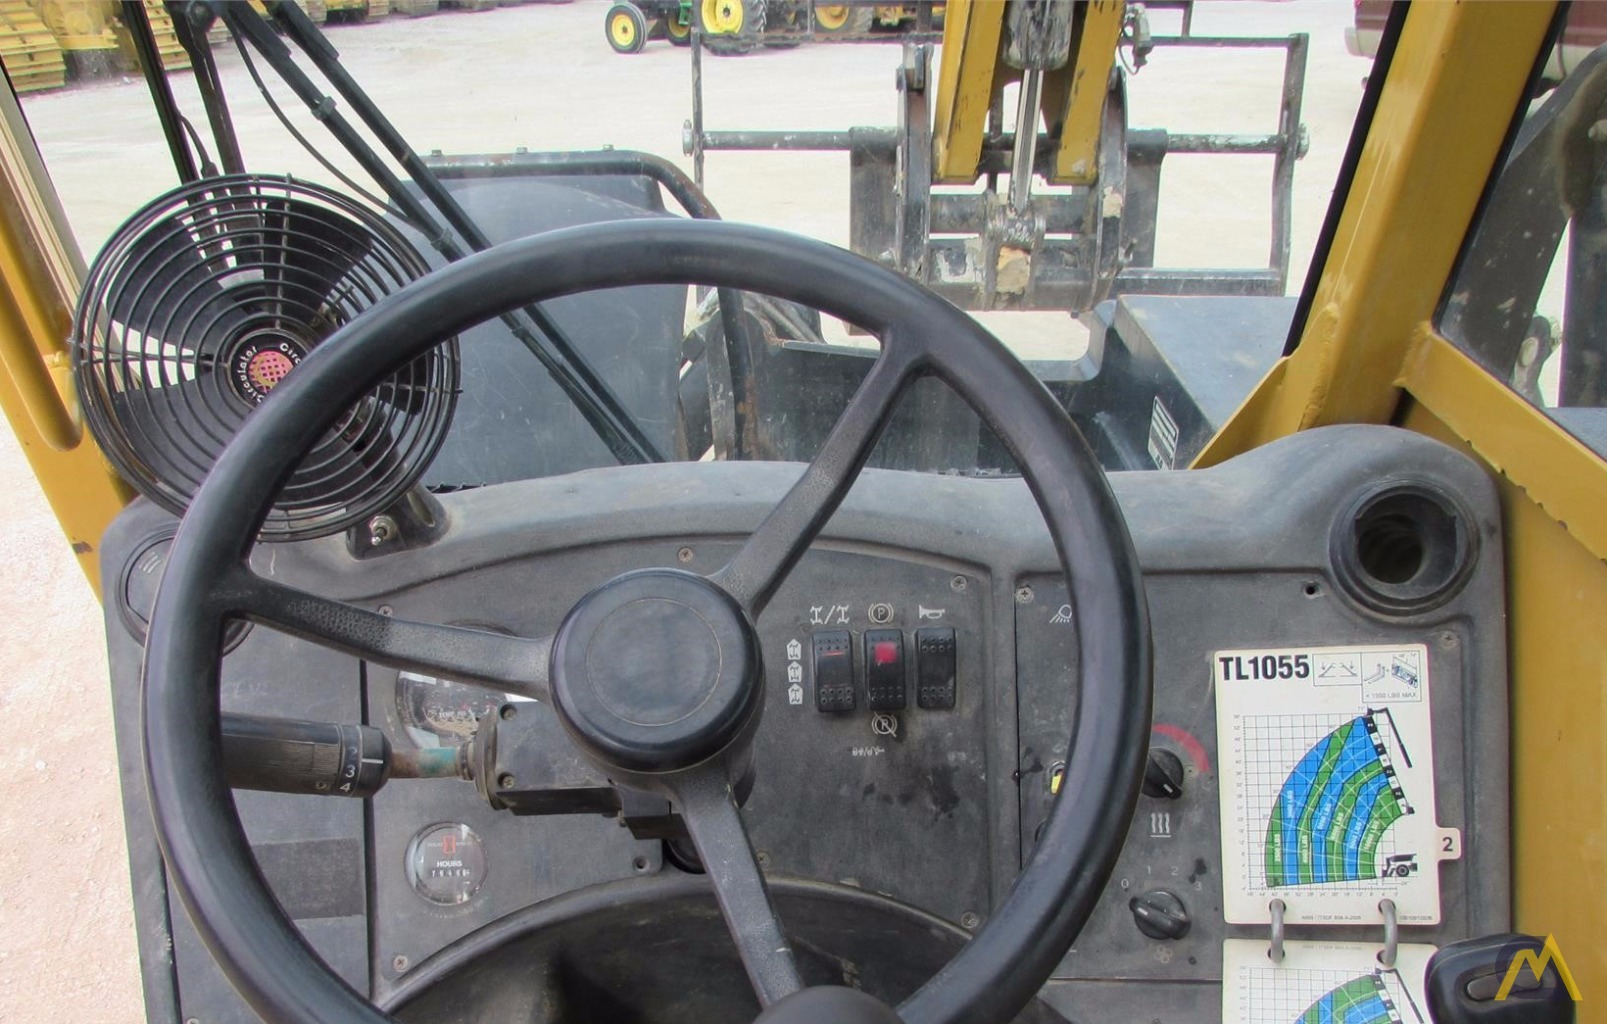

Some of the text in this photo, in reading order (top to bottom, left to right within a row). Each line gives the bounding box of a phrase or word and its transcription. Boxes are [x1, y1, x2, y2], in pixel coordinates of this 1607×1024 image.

[1218, 654, 1310, 681] TL1055
[345, 764, 356, 778] 3
[339, 782, 352, 793] 4
[1442, 837, 1454, 852] 2
[436, 859, 463, 868] HOURS
[1170, 865, 1179, 876] 2
[1194, 880, 1203, 891] 3
